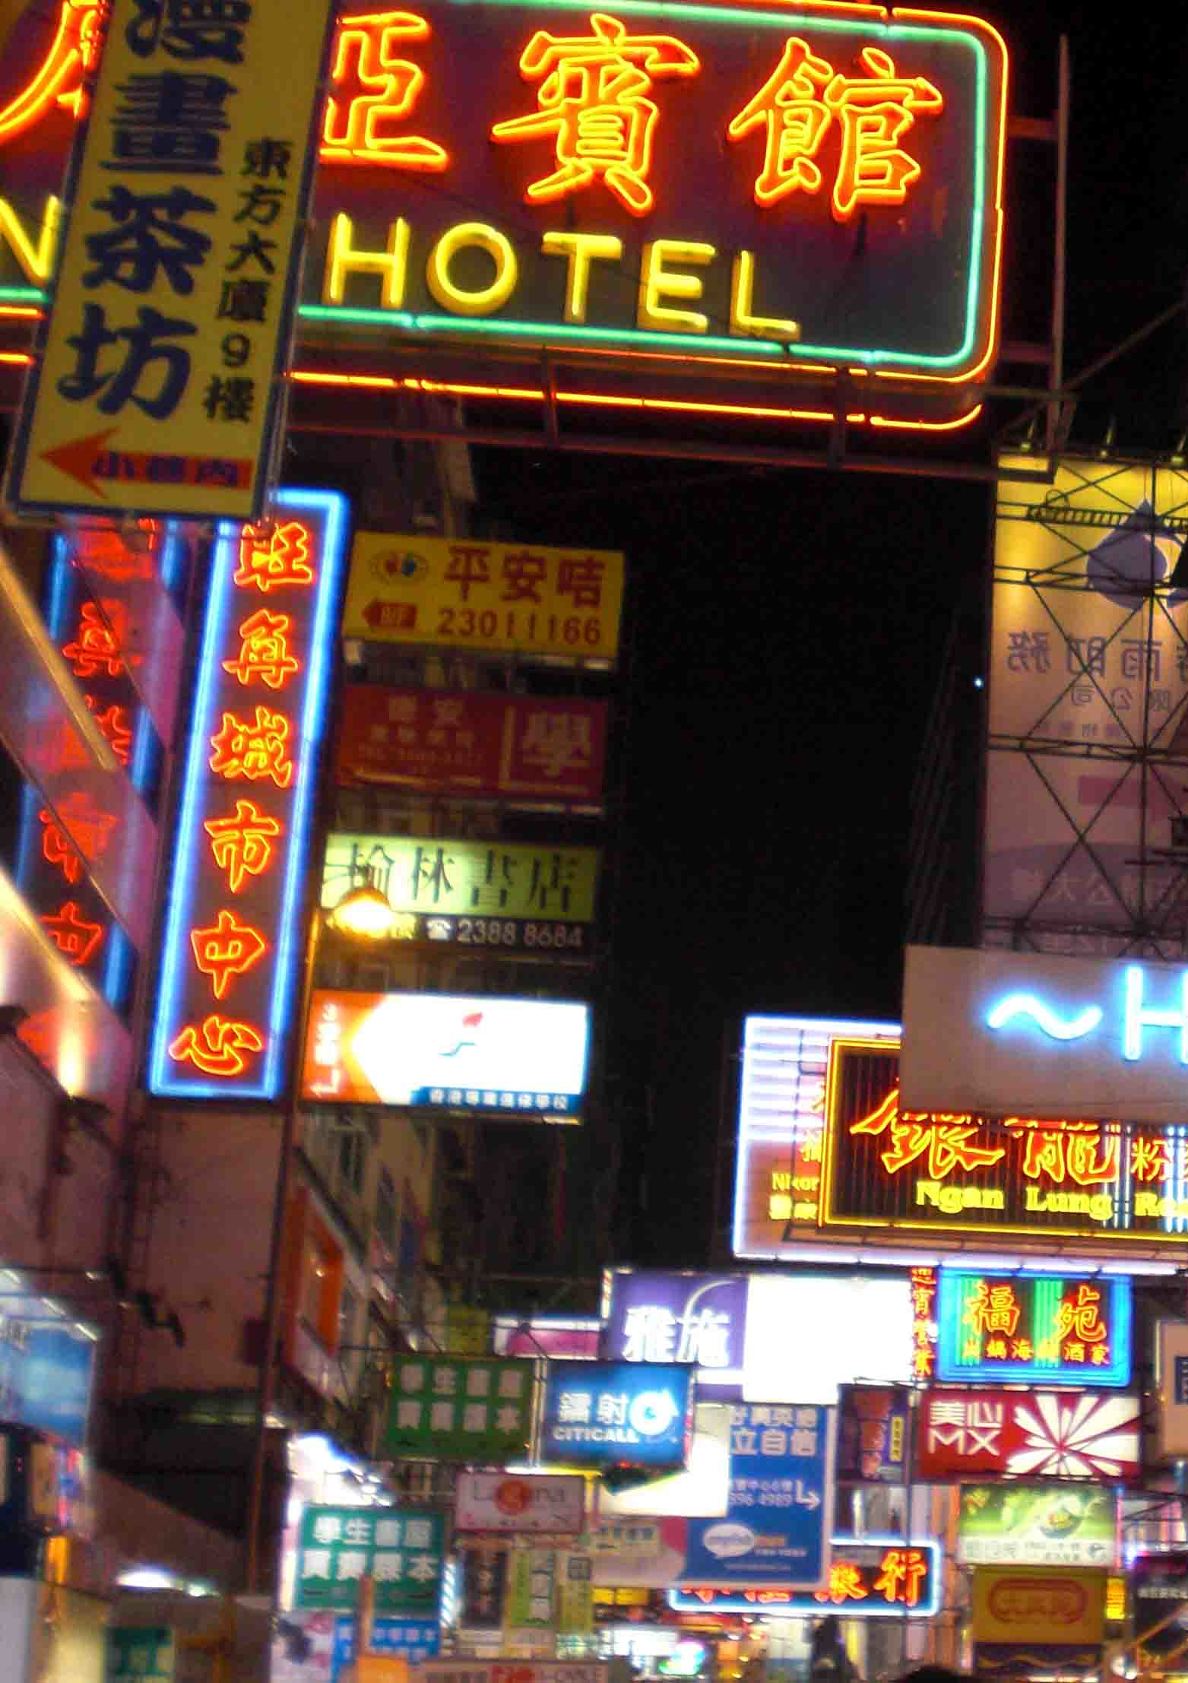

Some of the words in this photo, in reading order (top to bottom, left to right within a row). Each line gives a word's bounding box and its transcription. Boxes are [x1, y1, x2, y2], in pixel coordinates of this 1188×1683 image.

[322, 212, 799, 340] HOTEL
[444, 545, 606, 609] 平安咭
[167, 521, 314, 1077] 旺角城市中心
[457, 917, 517, 946] 2388
[916, 1180, 1005, 1214] Ngan
[1025, 1186, 1114, 1221] Lung
[929, 1402, 1002, 1429] 美心
[552, 1425, 640, 1443] CITICALL
[928, 1428, 1001, 1456] MX
